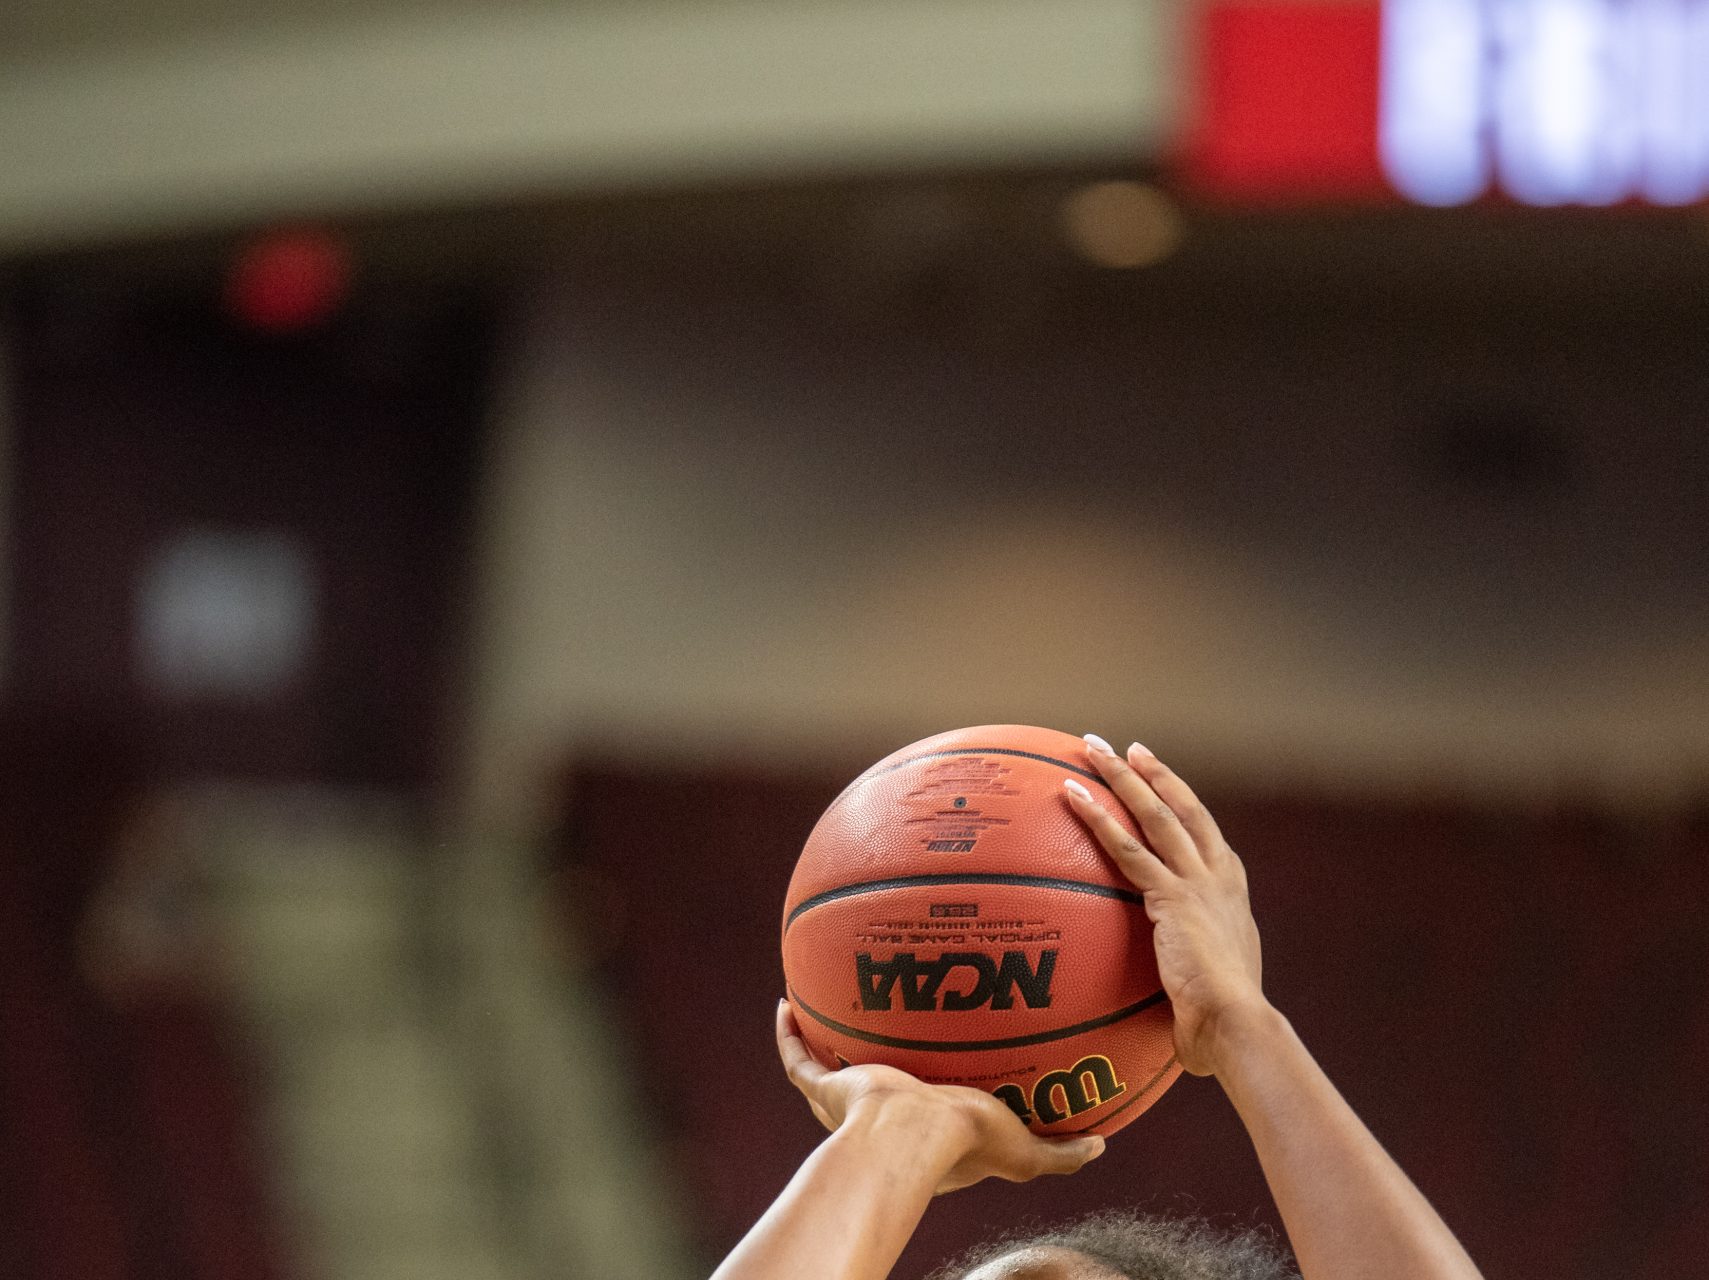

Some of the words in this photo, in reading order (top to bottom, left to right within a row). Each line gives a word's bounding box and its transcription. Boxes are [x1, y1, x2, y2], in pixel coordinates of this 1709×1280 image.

[856, 933, 903, 944] BALL
[907, 933, 964, 944] GAME
[971, 930, 1061, 944] OFFICIAL
[855, 949, 1059, 1011] NCAA
[967, 1065, 1037, 1082] SOLUTION
